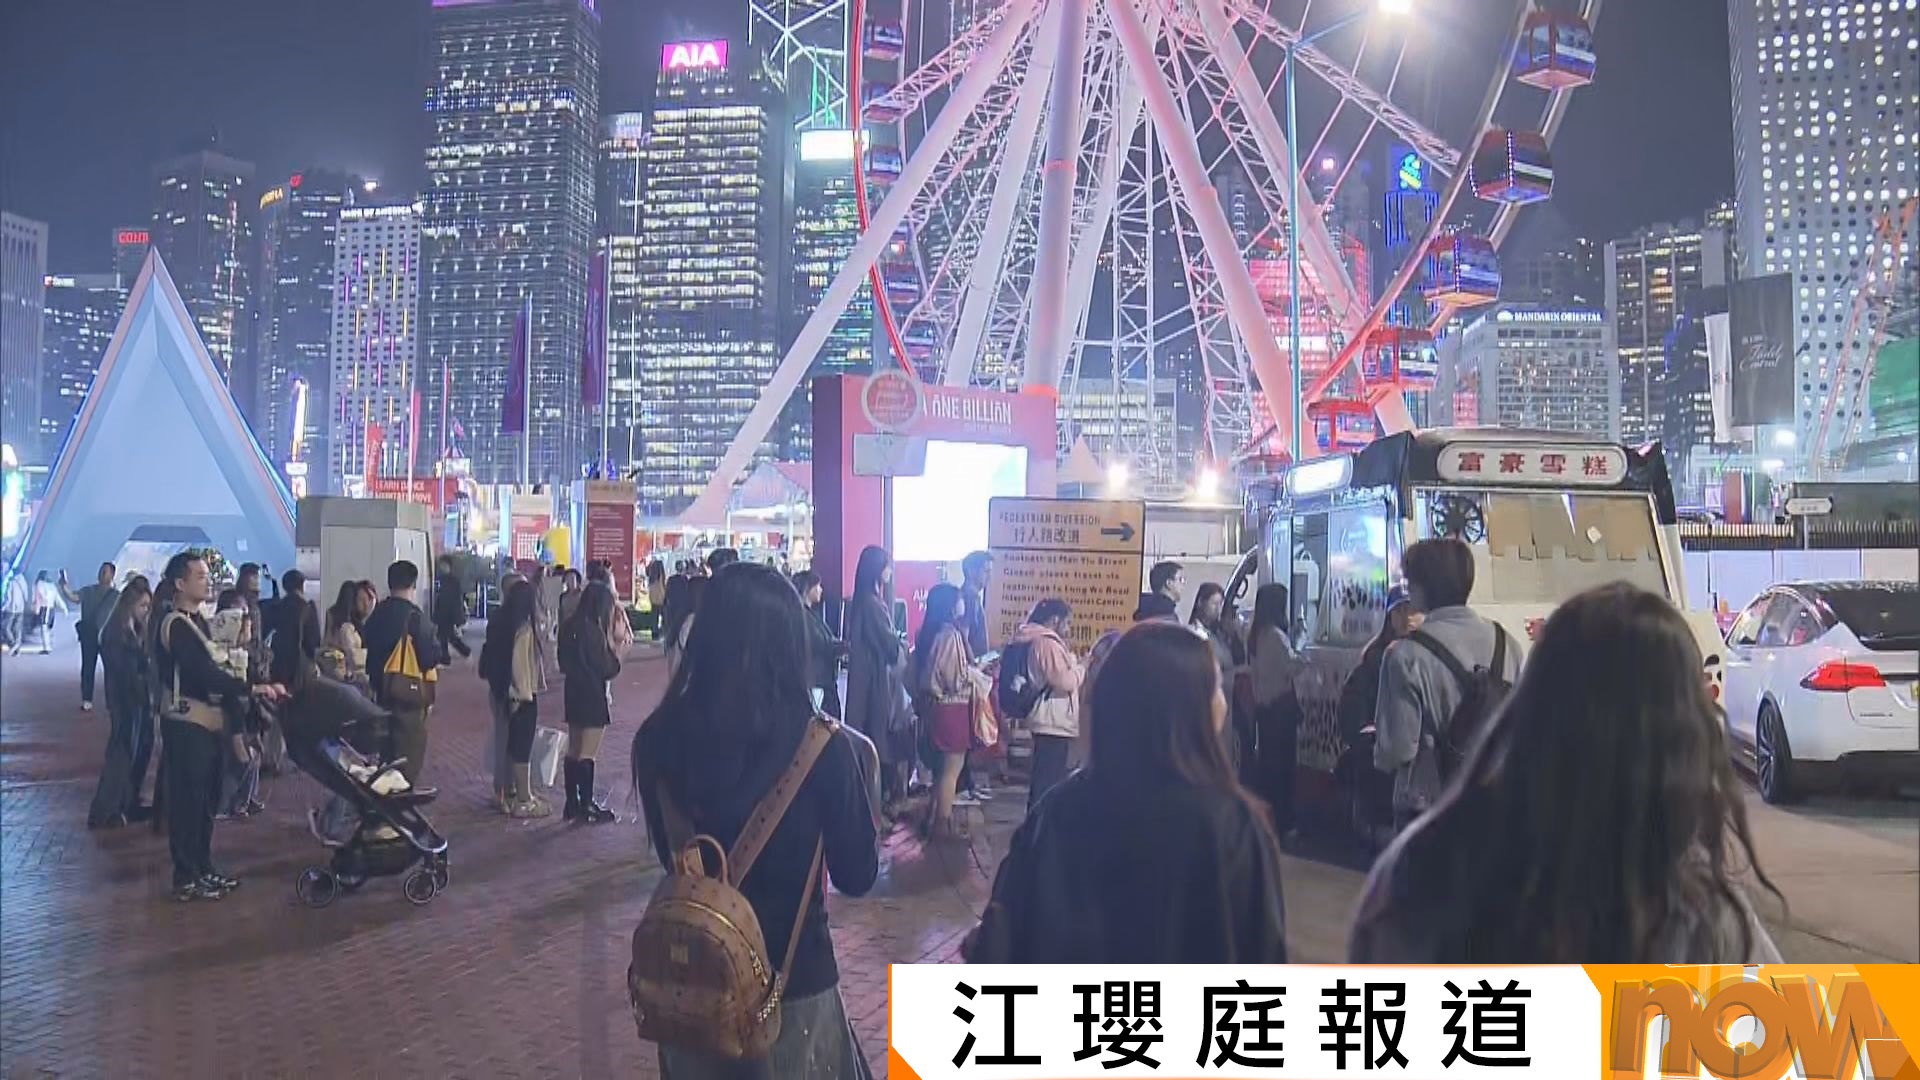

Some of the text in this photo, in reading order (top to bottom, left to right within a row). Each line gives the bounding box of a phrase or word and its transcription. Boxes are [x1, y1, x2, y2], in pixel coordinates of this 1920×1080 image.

[669, 34, 720, 67] AIA
[1514, 311, 1602, 322] MANDARIN ORIENTAL
[1457, 452, 1608, 476] 富豪雪糕
[1000, 512, 1101, 526] PEDESTRIAN DIVERSION
